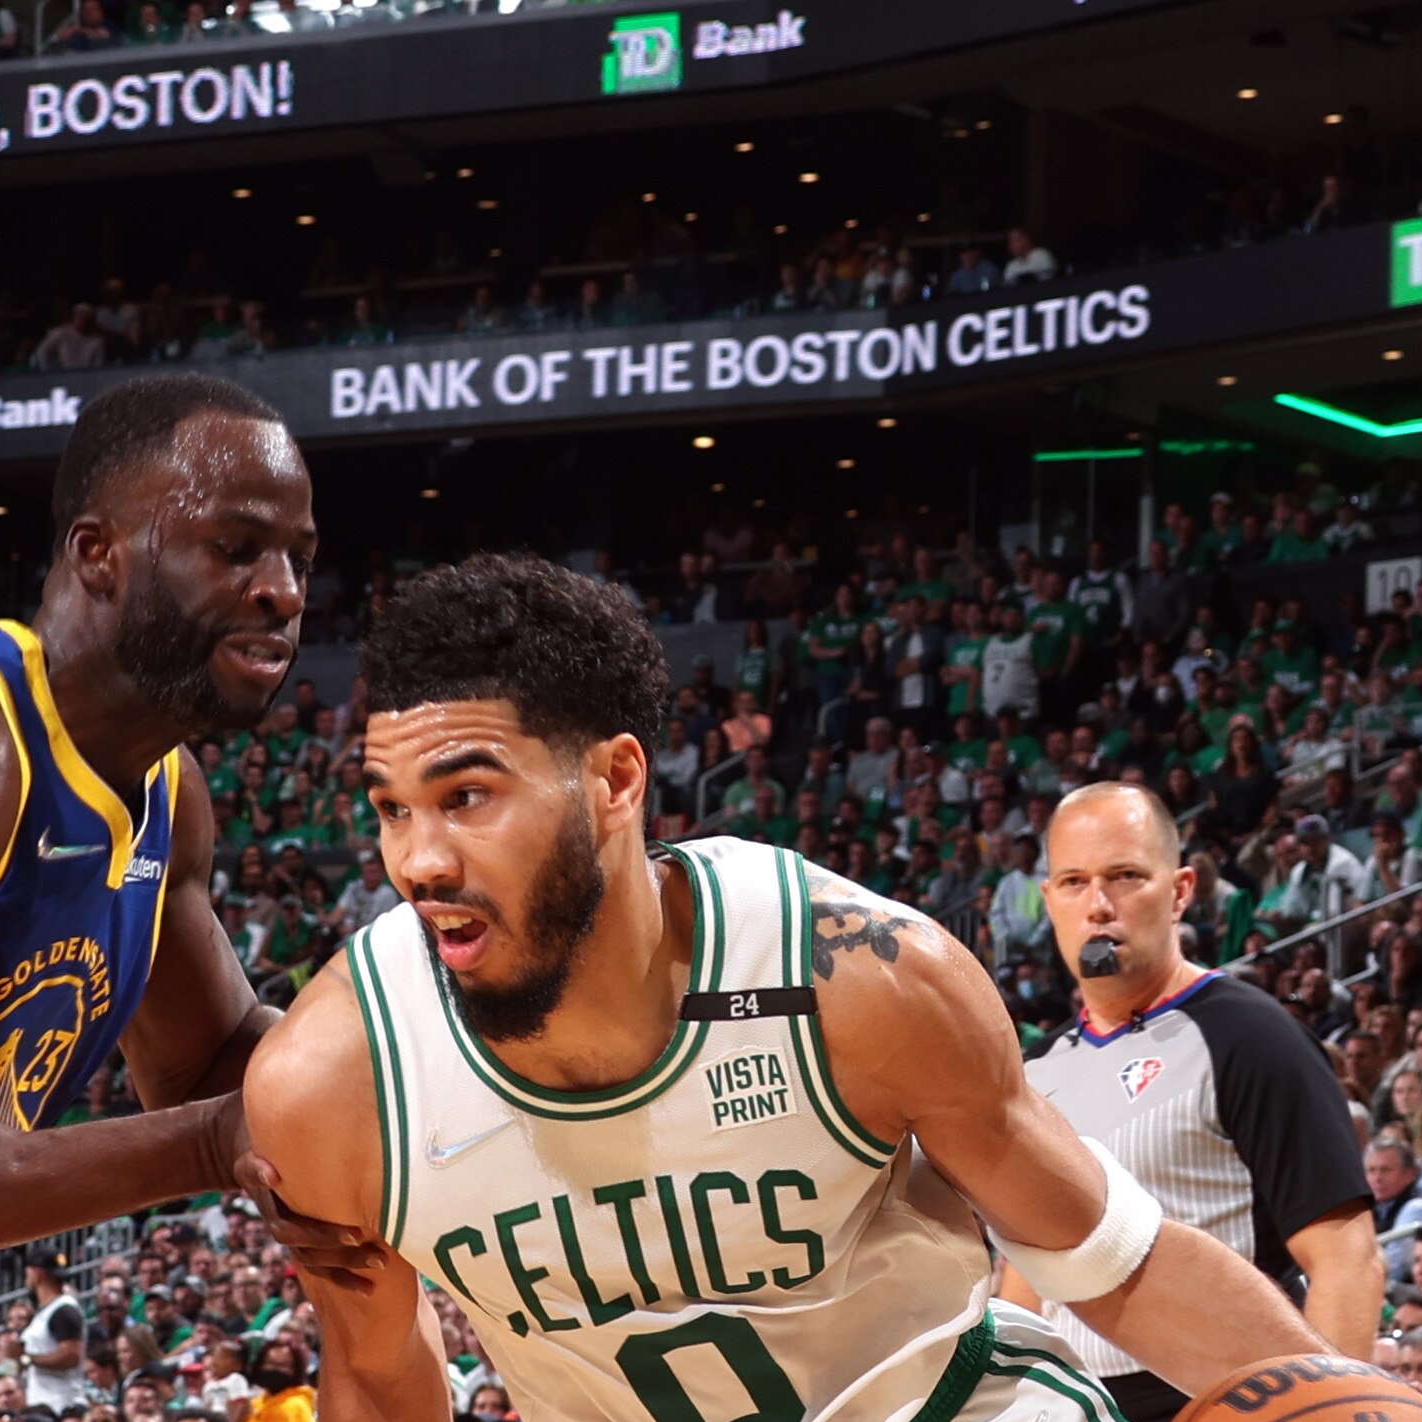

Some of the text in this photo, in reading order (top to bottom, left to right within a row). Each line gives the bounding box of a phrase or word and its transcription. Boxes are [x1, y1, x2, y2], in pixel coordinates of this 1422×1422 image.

[694, 10, 806, 59] Bank
[25, 60, 292, 140] BOSTON!
[331, 285, 1151, 418] BANK OF THE BOSTON CELTICS
[88, 940, 111, 1022] STATE
[730, 993, 760, 1018] 24
[16, 1029, 76, 1093] 23
[705, 1053, 787, 1100] VISTA
[712, 1088, 788, 1127] PRINT
[433, 1169, 825, 1338] CELTICS
